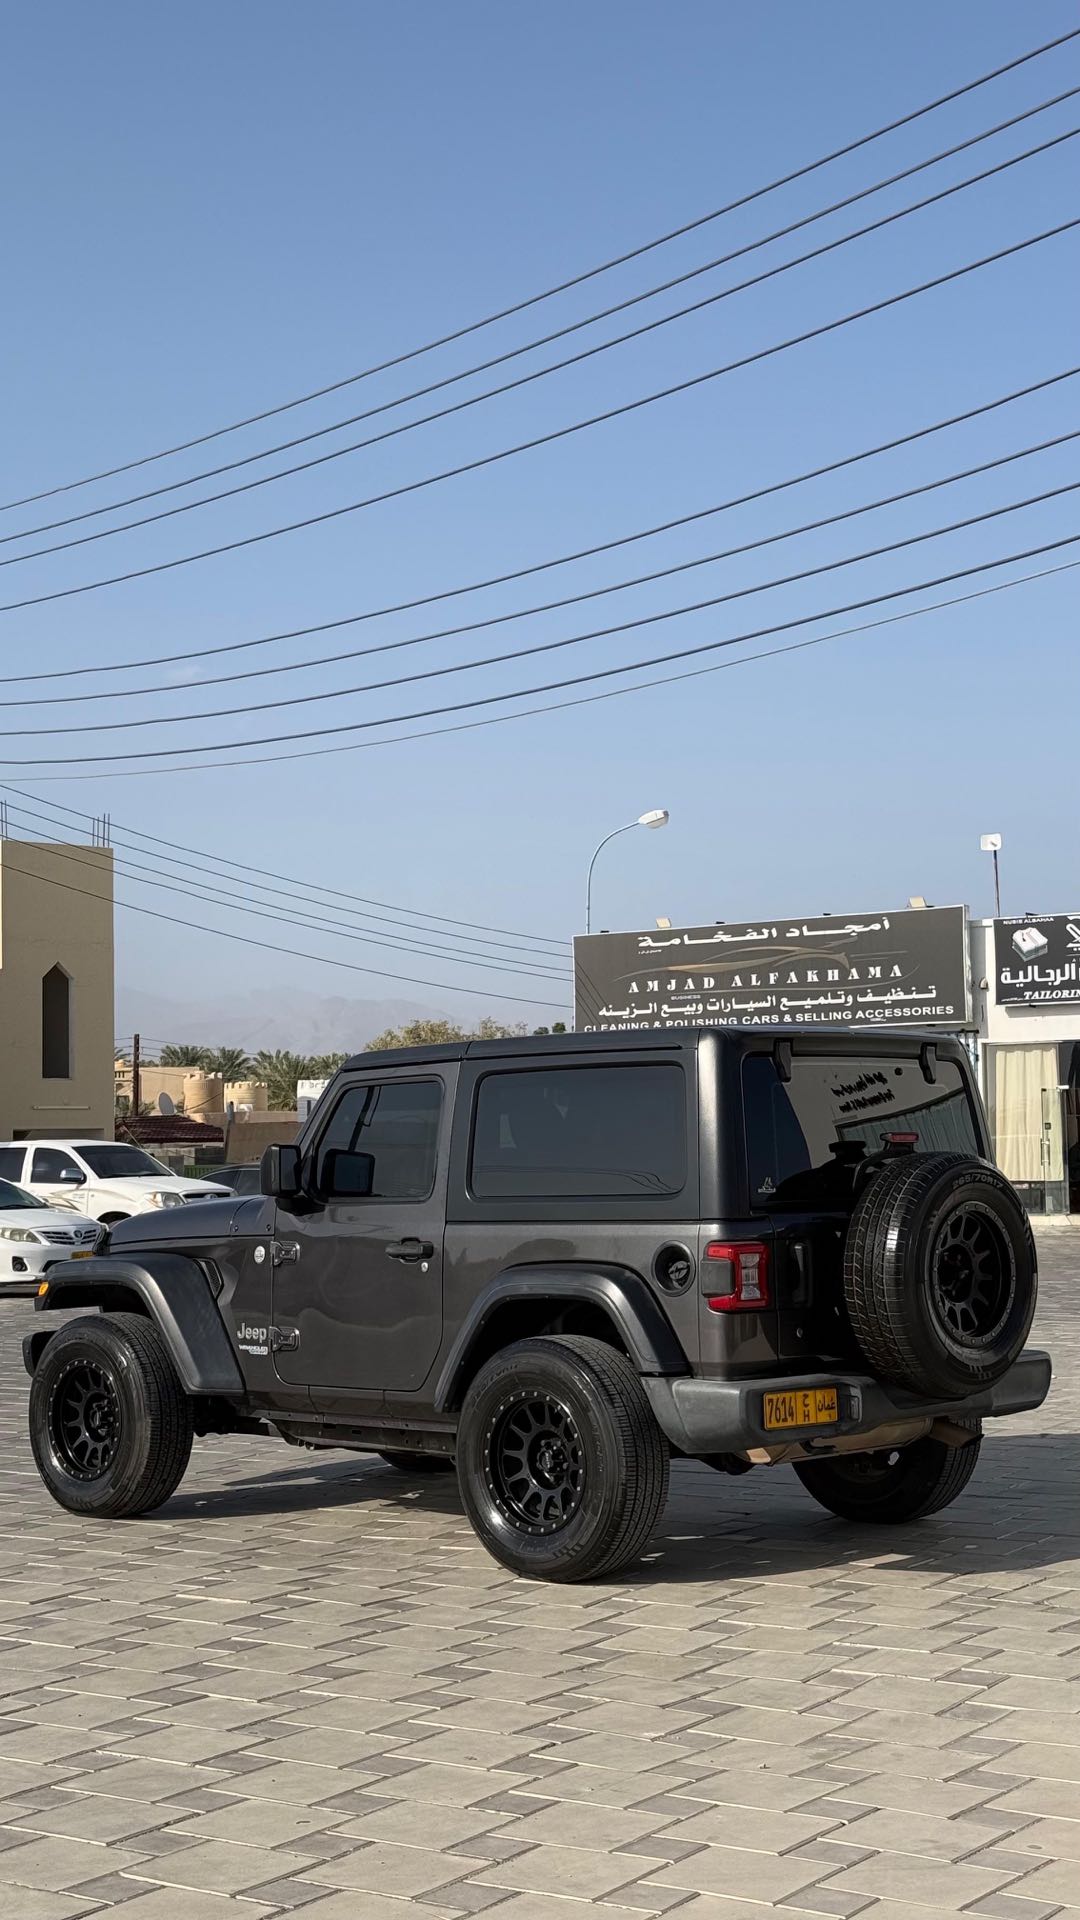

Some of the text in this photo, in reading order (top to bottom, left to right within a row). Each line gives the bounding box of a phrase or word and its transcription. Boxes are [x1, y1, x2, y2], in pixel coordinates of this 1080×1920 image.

[638, 917, 890, 948] أمجاد الفخامة
[628, 964, 902, 994] AMJAD ALFAKHAMA
[598, 985, 937, 1018] تنظيف وتلميع السيارات وبيع الزينه
[653, 1020, 661, 1028] &
[742, 1013, 779, 1025] CARS
[783, 1013, 792, 1023] &
[795, 1010, 852, 1022] SELLING
[855, 1006, 954, 1019] ACCESSORIES
[236, 1322, 267, 1344] Jeep
[767, 1396, 795, 1424] 7614
[803, 1409, 810, 1422] H
